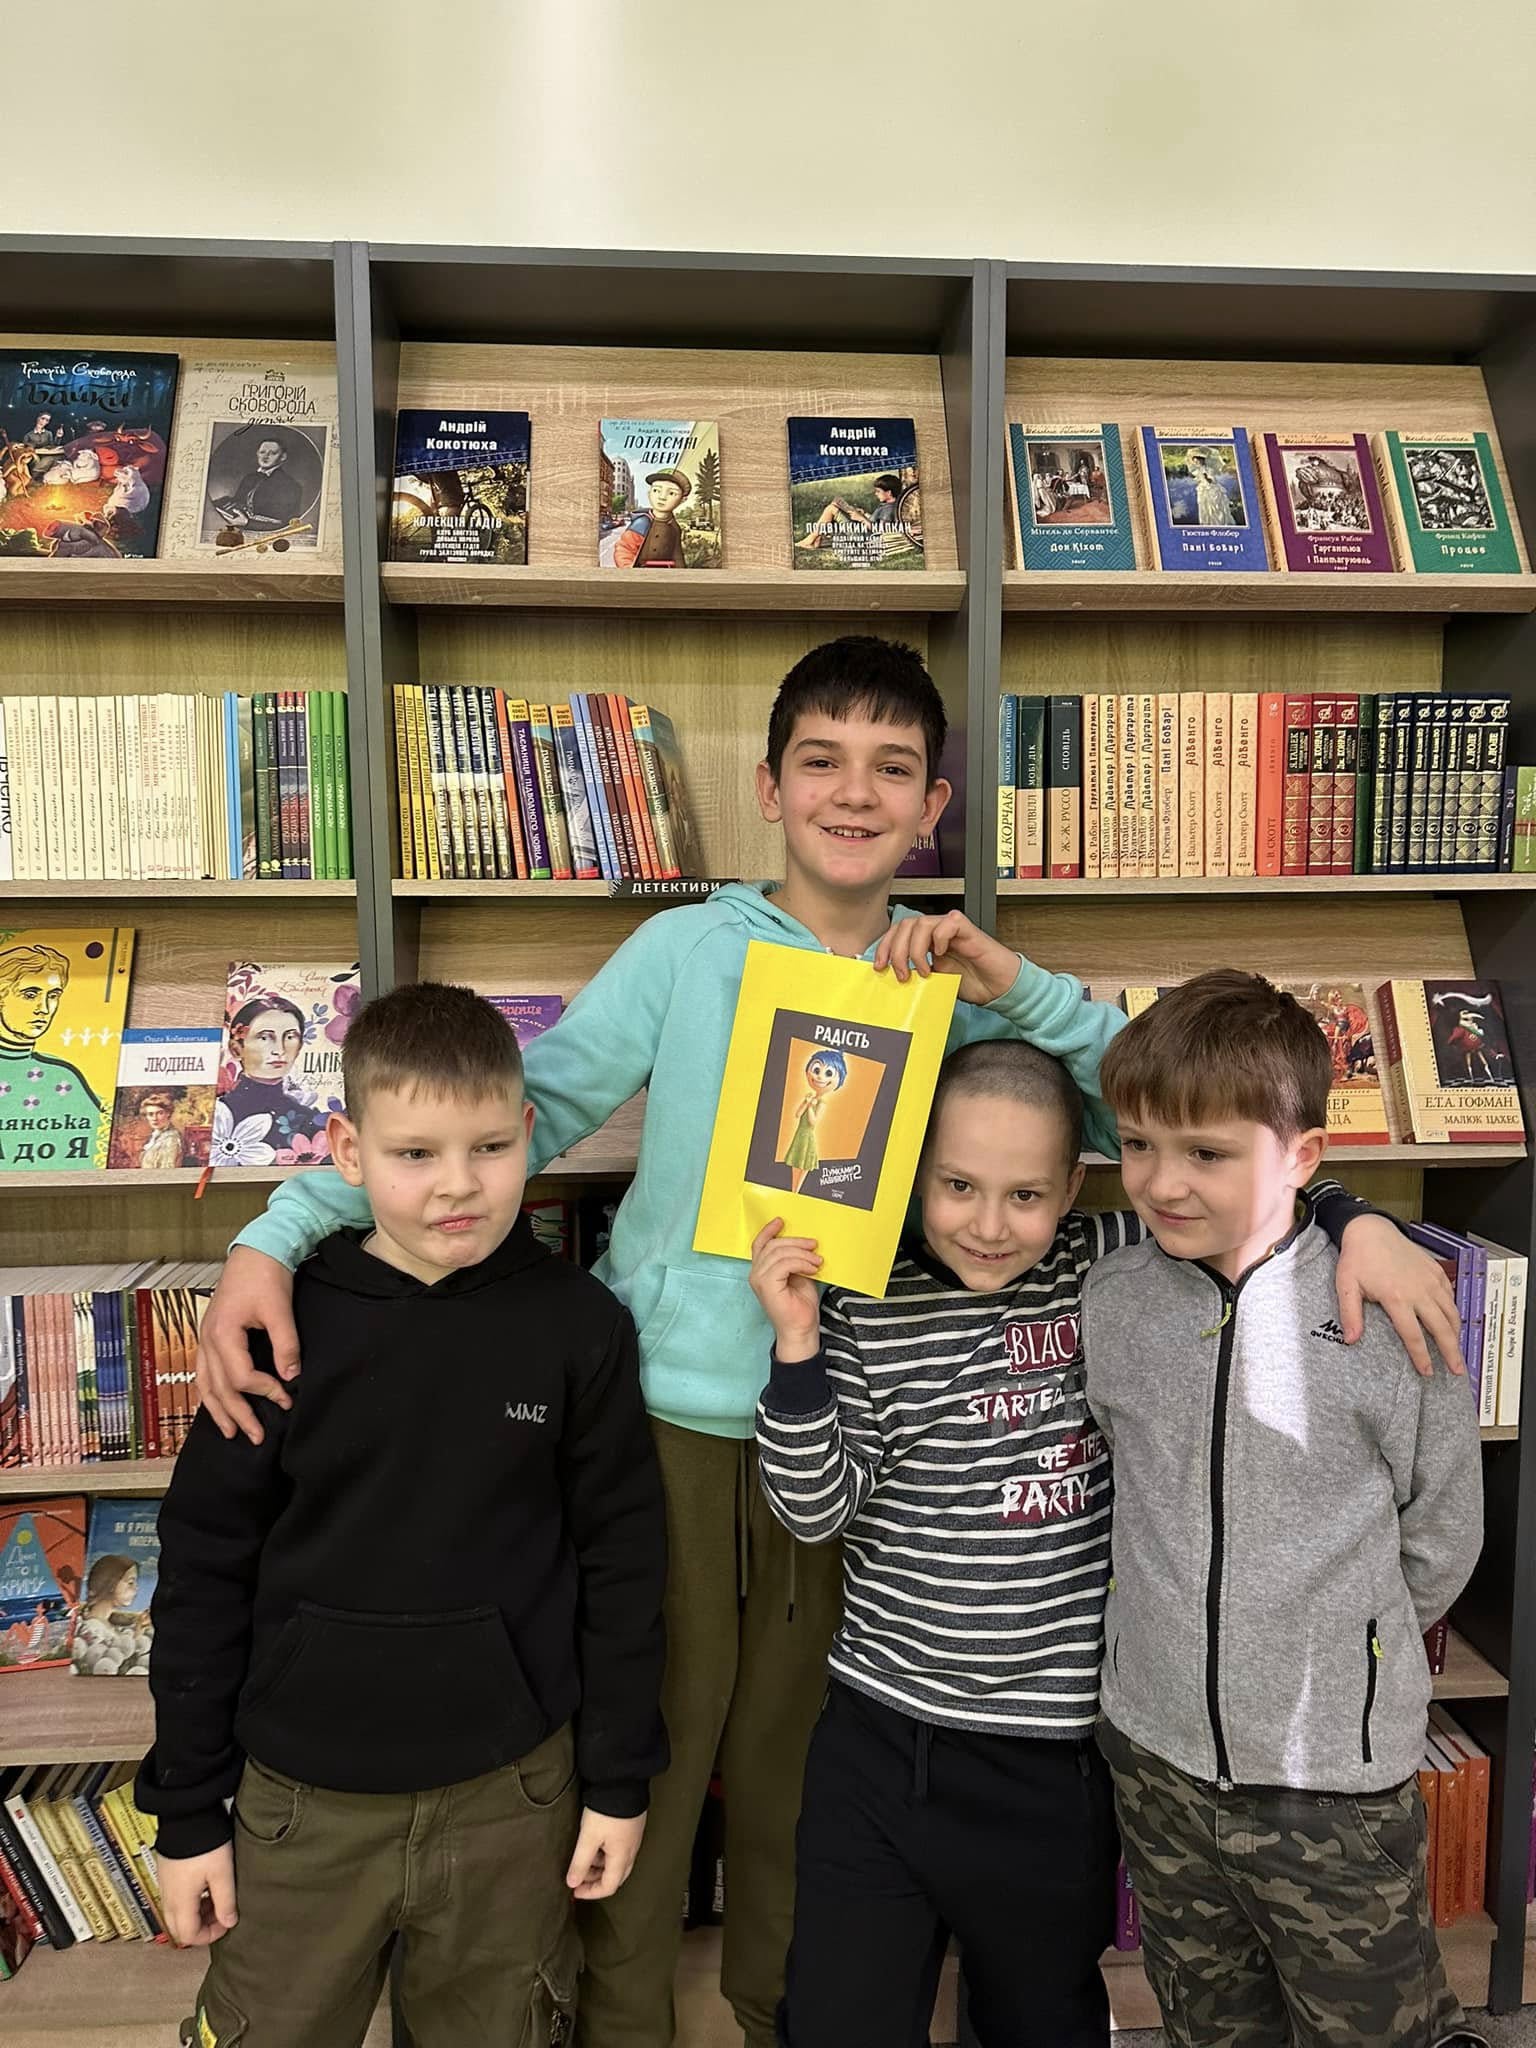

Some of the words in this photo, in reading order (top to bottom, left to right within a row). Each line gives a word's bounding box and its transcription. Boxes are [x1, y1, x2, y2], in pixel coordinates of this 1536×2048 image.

[242, 383, 307, 401] ГРИГОРІЙ
[228, 397, 316, 415] СКОВОРОДА
[439, 420, 487, 434] Андрій
[830, 426, 876, 440] Андрій
[426, 437, 498, 451] Кокотюха
[624, 435, 698, 450] ПОТАЄМНІ
[820, 444, 889, 456] Кокотюха
[639, 451, 680, 465] ДВЕРІ
[413, 516, 466, 529] КОЛЕКЦІЯ
[806, 522, 868, 535] ПОДВІЙНИЙ
[872, 522, 912, 533] КАПКАН
[1104, 698, 1115, 753] Маргарита
[1125, 697, 1136, 752] Маргарита
[1141, 698, 1152, 752] Маргарита
[1161, 707, 1174, 744] Боварі
[1028, 744, 1036, 760] ДІК
[1062, 728, 1071, 770] СПОВІДЬ
[1186, 716, 1199, 766] Айвенго
[1213, 717, 1225, 767] Айвенго
[1238, 718, 1251, 768] Айвенго
[1161, 748, 1170, 773] Пані
[1028, 763, 1036, 787] МОБІ
[518, 728, 531, 776] ТАЄМНИЦЯ
[527, 777, 538, 831] ПІДВОДНОГО
[533, 832, 542, 861] ЧОВНА
[1062, 789, 1071, 823] РУССО
[1001, 791, 1013, 844] КОРЧАК
[1027, 795, 1037, 837] МЕЛВІЛЛ
[1267, 818, 1276, 848] СКОТТ
[632, 883, 720, 895] ДЕТЕКТИВИ
[814, 1025, 870, 1049] РАДІСТЬ
[144, 1056, 205, 1075] ЛЮДИНА
[303, 1052, 344, 1074] ЦАРІВ
[1327, 1098, 1350, 1110] ЕР
[1459, 1096, 1513, 1108] ГОФМАН
[1444, 1115, 1483, 1125] МАЛЮК
[1486, 1114, 1520, 1126] ЦАХЕС
[13, 1143, 55, 1163] до
[65, 1136, 90, 1158] Я
[853, 1165, 862, 1180] 2
[1310, 1330, 1350, 1346] QUECHU
[1487, 1350, 1496, 1374] ТЕАТР
[967, 1388, 1065, 1422] STARTED
[1484, 1374, 1495, 1415] АНТИЧНИЙ
[1001, 1473, 1091, 1519] PARTY
